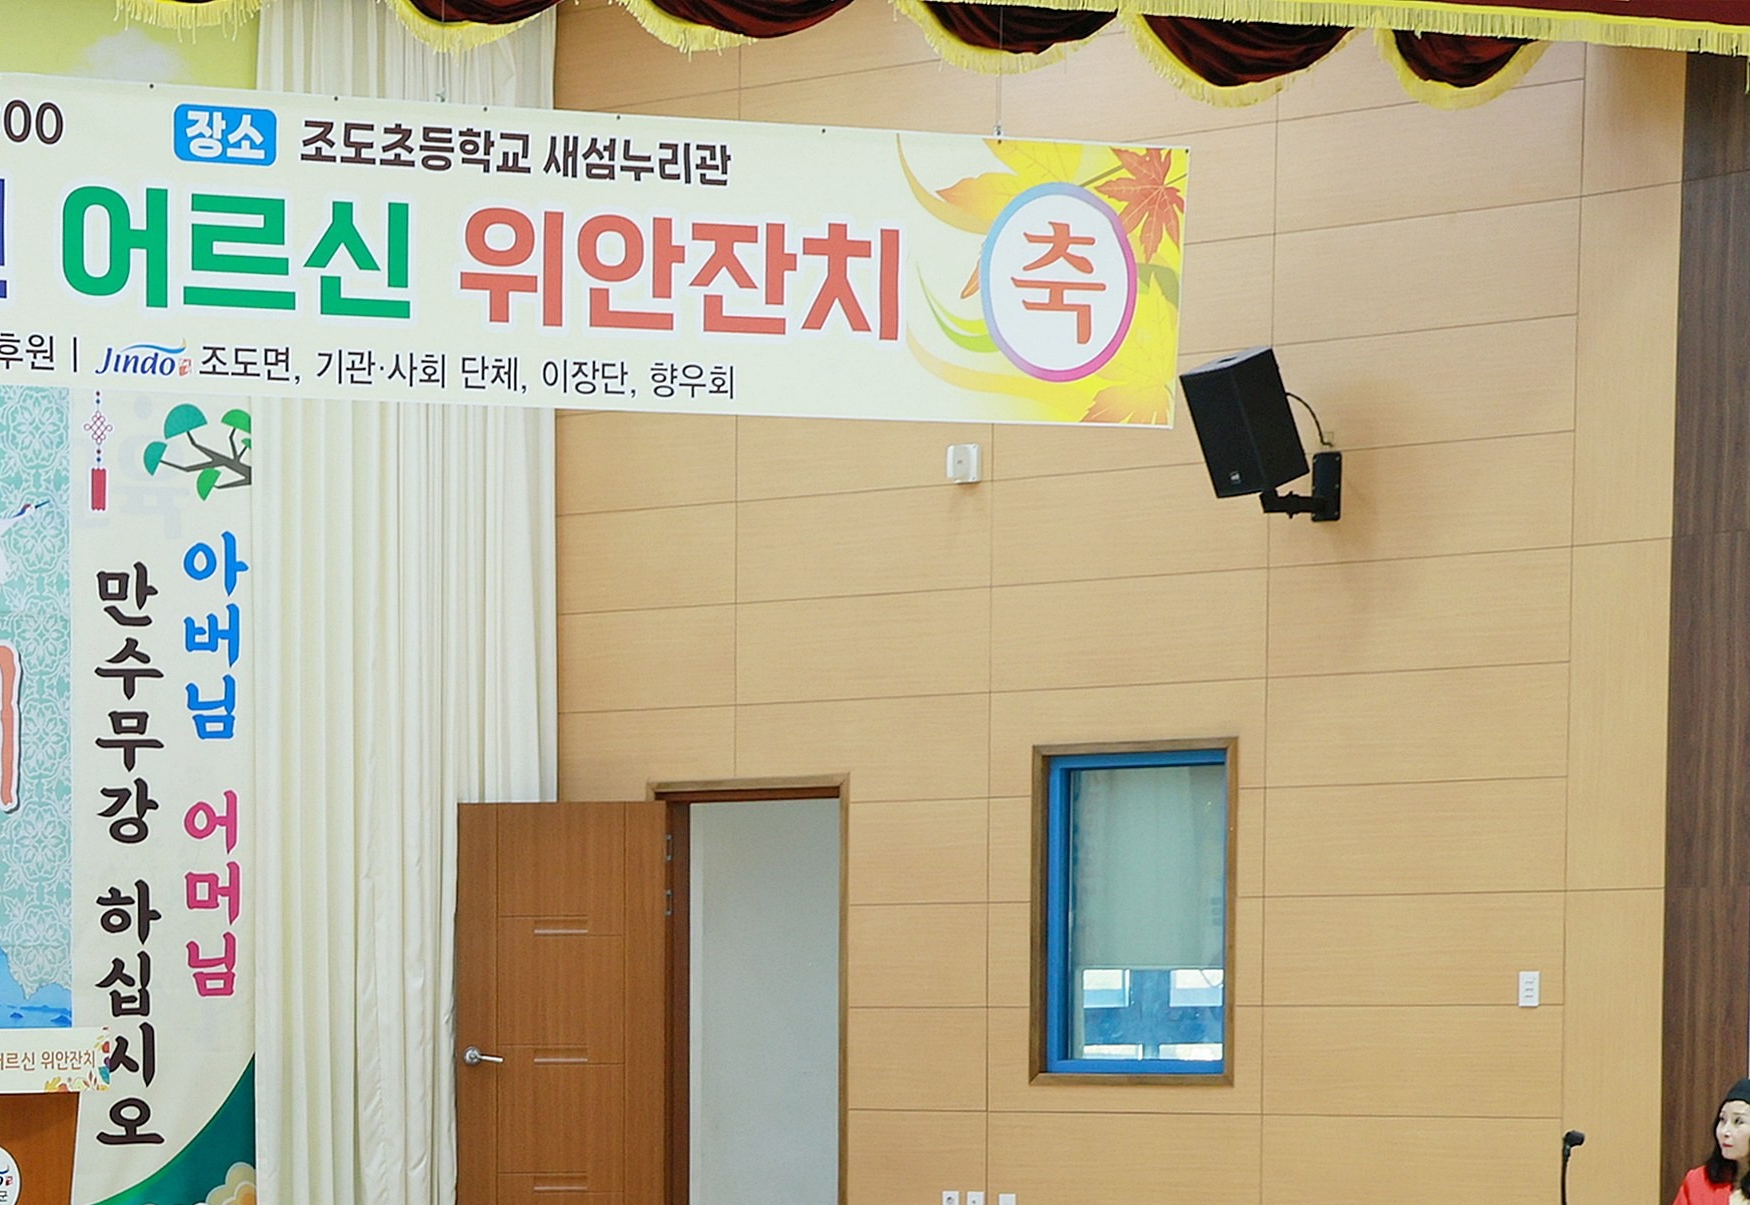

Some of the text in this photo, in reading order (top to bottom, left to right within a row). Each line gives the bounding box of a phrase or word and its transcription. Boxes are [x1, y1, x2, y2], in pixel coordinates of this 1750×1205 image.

[184, 109, 732, 187] 장소 조도초등학교 새섬누리관
[61, 185, 411, 320] 어르신
[459, 206, 901, 342] 위안잔치
[1010, 221, 1107, 345] 축
[199, 344, 301, 384] 조도면,
[315, 349, 448, 390] 기관·사회
[461, 354, 528, 393] 단체,
[543, 359, 637, 398] 이장단,
[650, 361, 736, 400] 향우회
[183, 531, 249, 998] 아버님 어머님
[94, 561, 166, 1147] 만수무강 하십시오
[41, 1049, 96, 1071] 위안잔치
